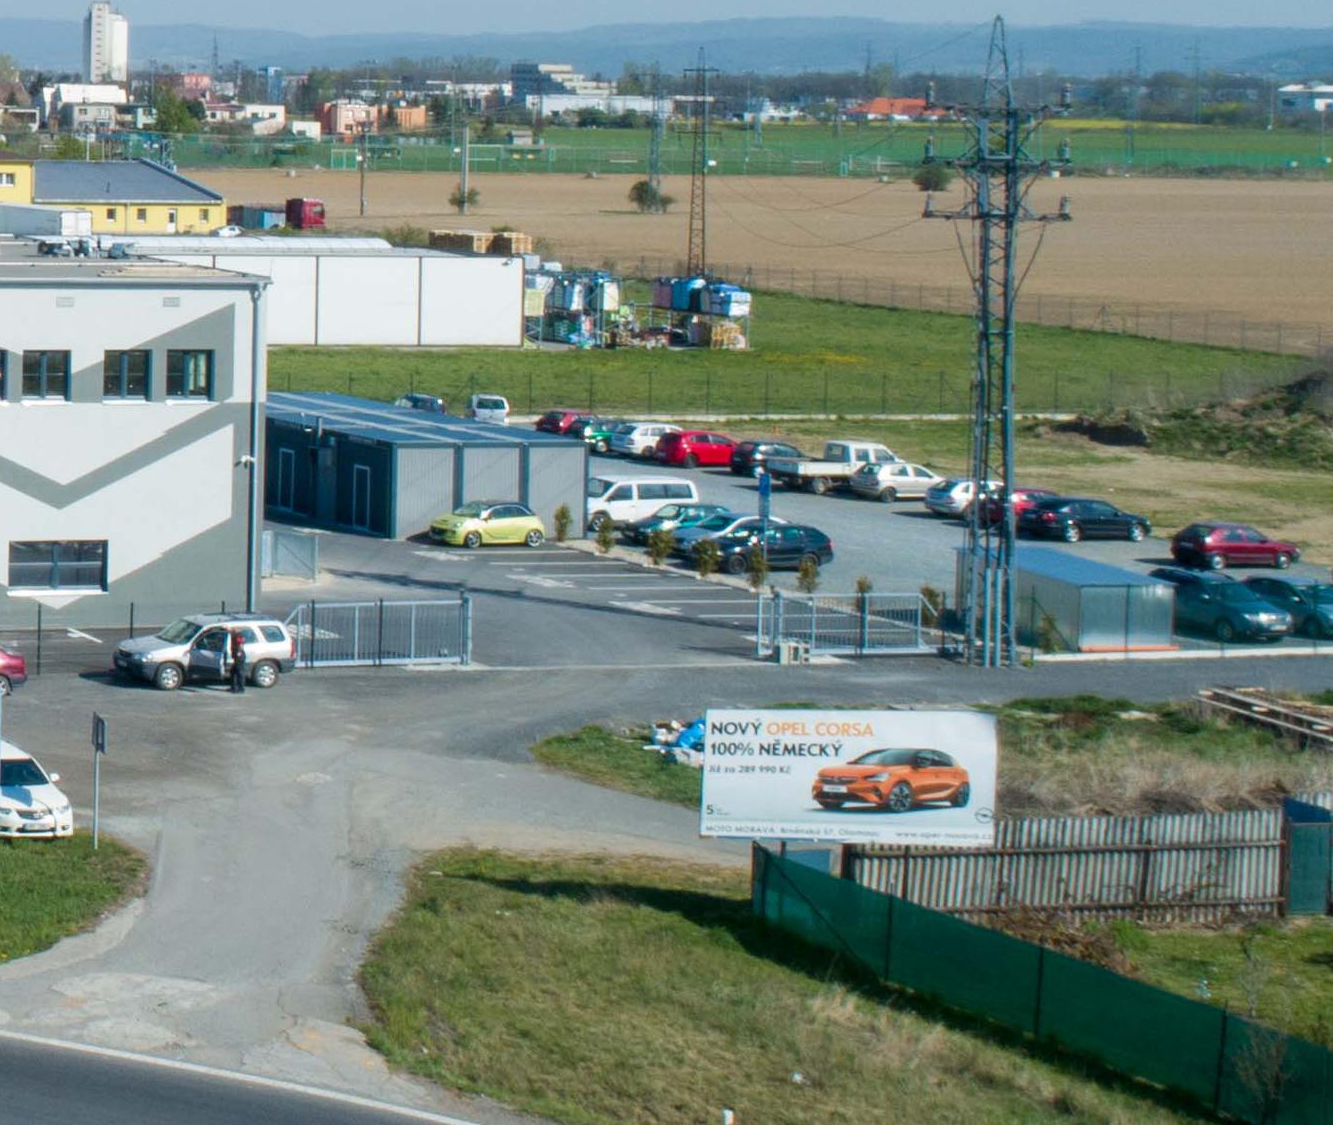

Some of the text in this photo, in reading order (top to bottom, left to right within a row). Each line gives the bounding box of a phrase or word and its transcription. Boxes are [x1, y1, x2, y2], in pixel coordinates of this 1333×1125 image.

[710, 717, 874, 737] NOVÝ OPEL CORSA
[710, 737, 843, 757] 100% NĚMECKÝ
[706, 804, 714, 815] 5
[705, 824, 732, 832] MOTO
